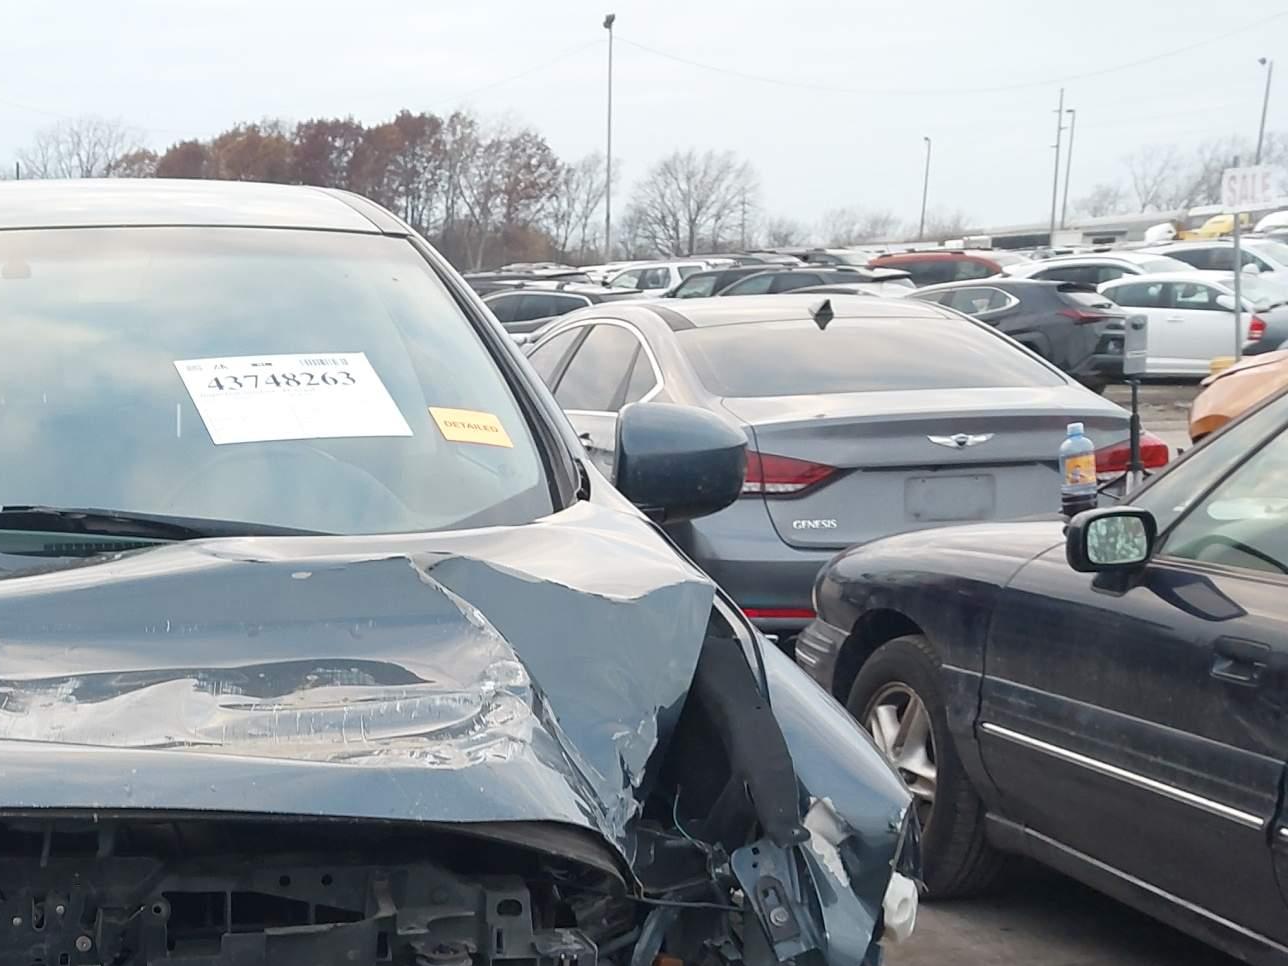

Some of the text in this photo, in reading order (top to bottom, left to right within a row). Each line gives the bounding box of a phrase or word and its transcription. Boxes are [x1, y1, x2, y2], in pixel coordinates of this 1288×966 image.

[1226, 172, 1271, 207] SALE
[208, 371, 356, 390] 43748263
[792, 519, 838, 529] GENESIS
